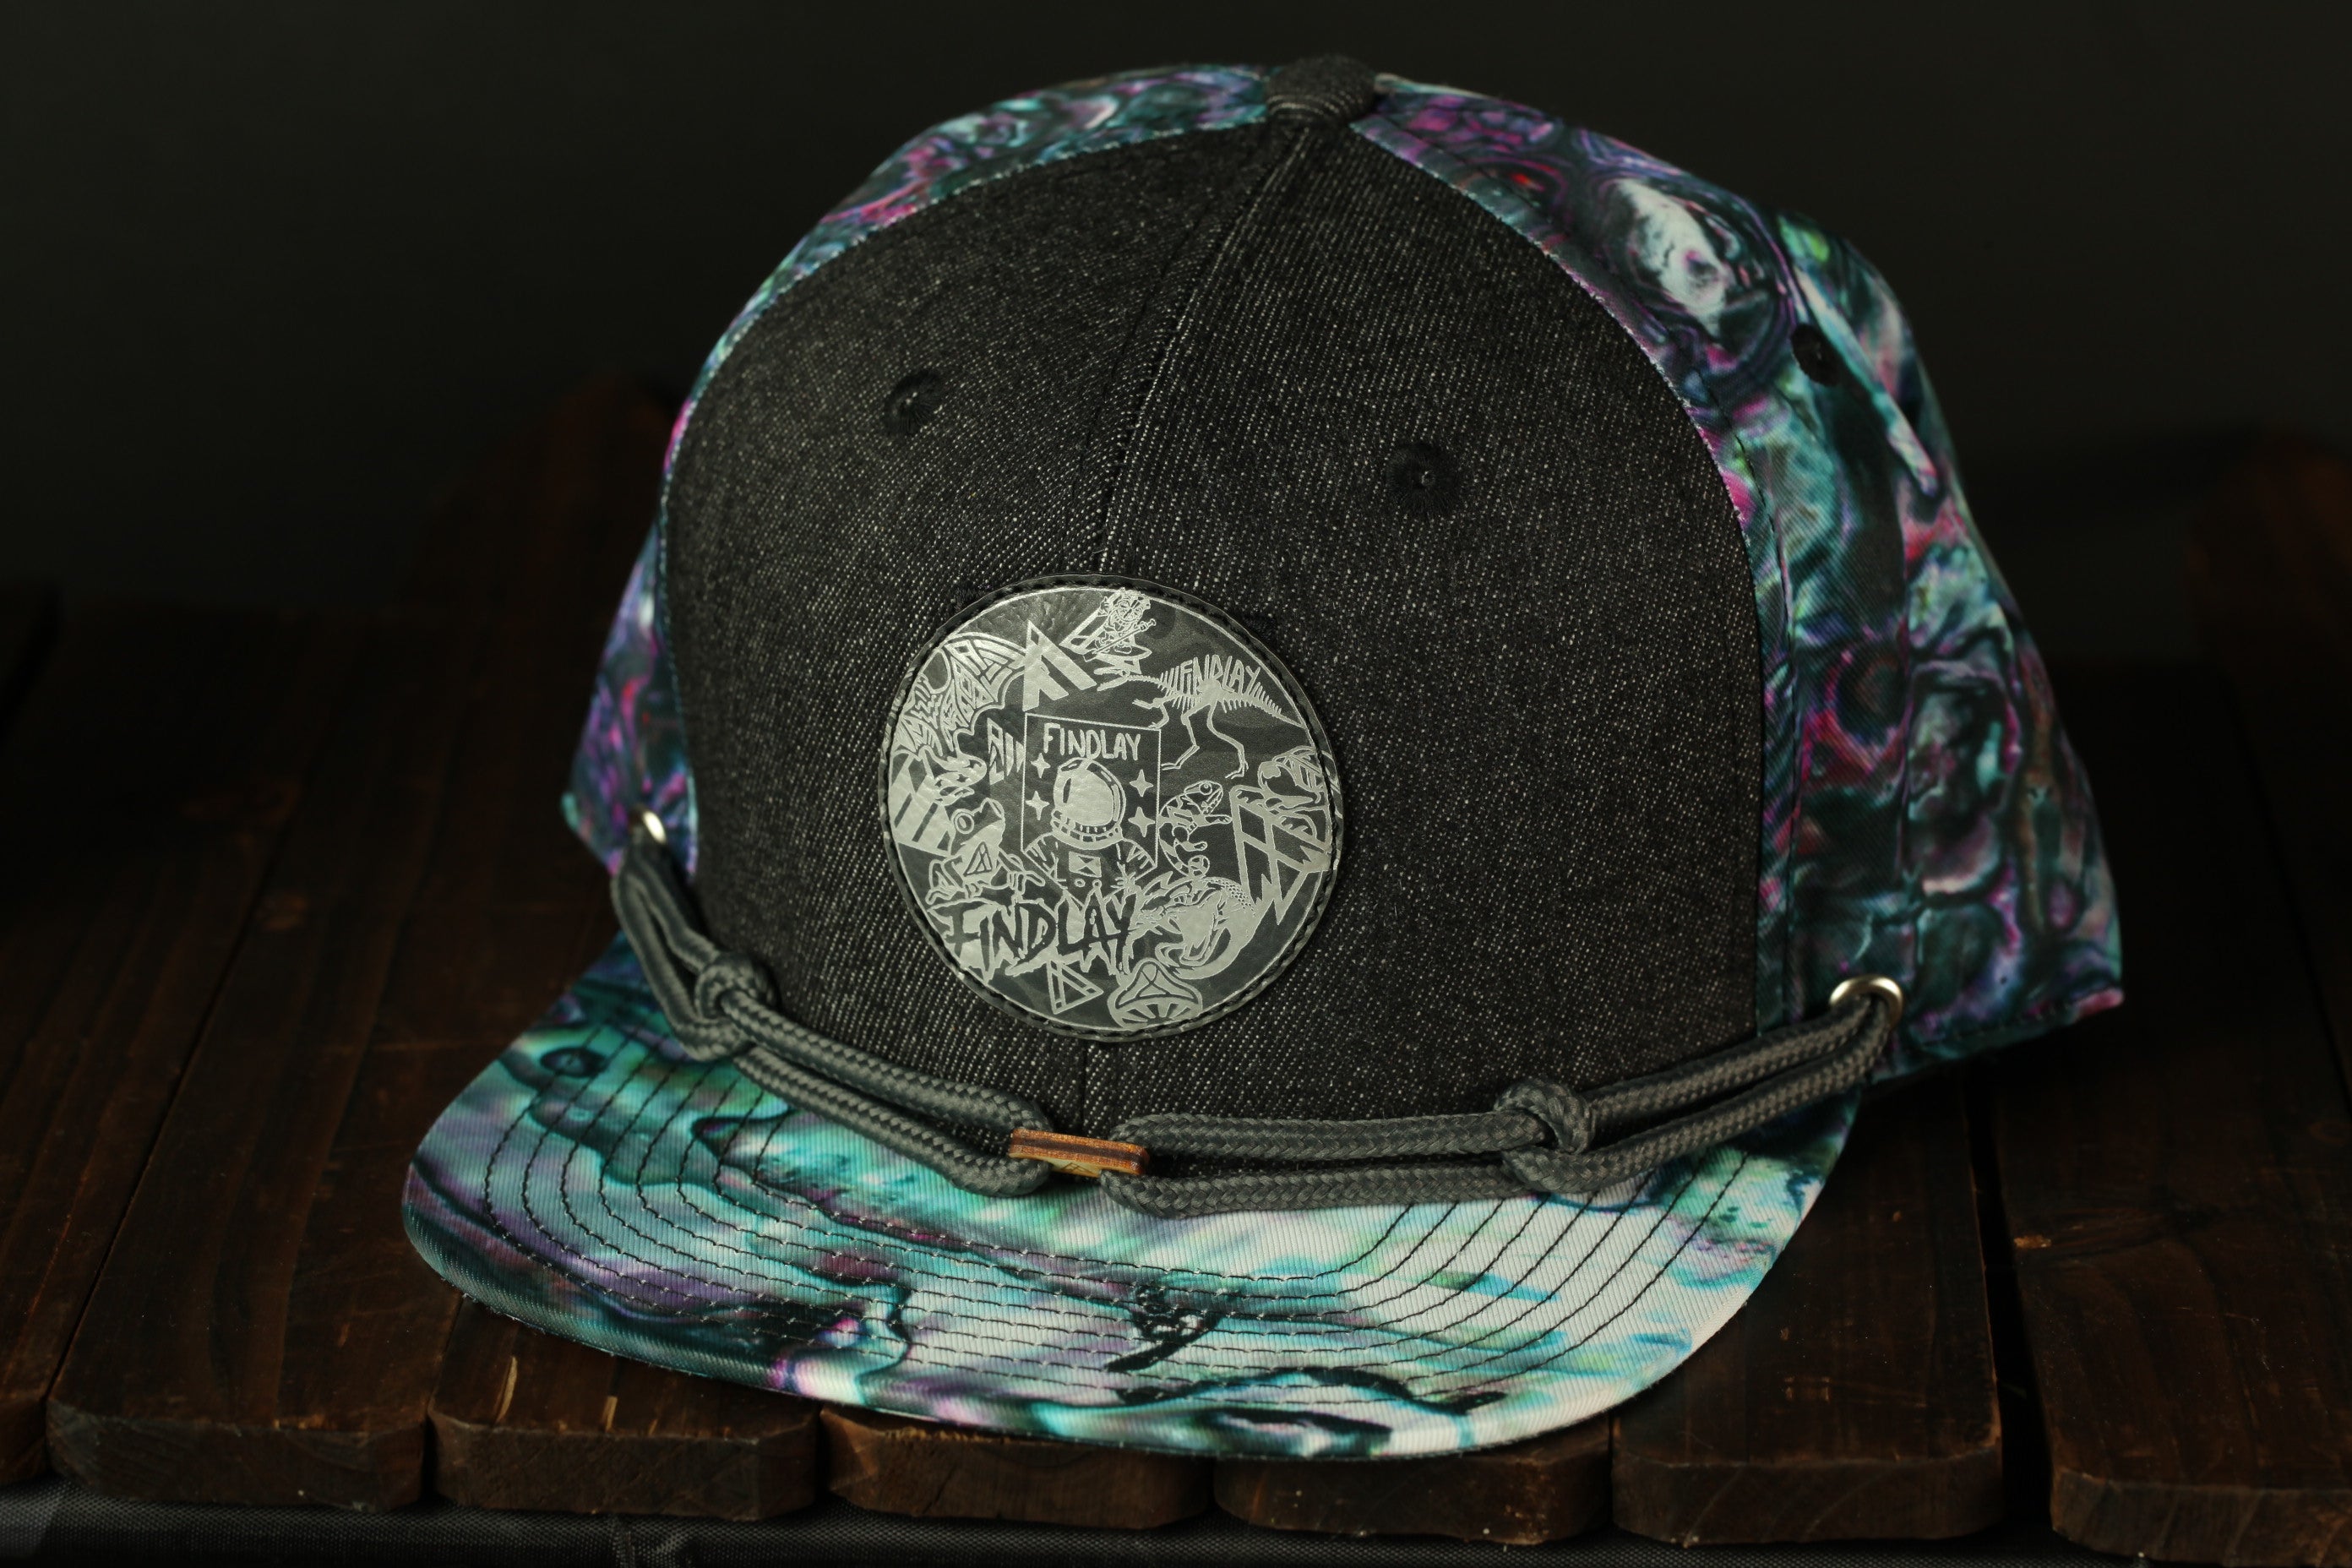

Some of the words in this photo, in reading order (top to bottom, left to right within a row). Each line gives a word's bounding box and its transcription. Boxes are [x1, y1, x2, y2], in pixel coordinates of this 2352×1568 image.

[1180, 654, 1261, 696] FINDLAY
[1043, 722, 1141, 761] FINDLAY
[928, 890, 1138, 978] FINDLAY
